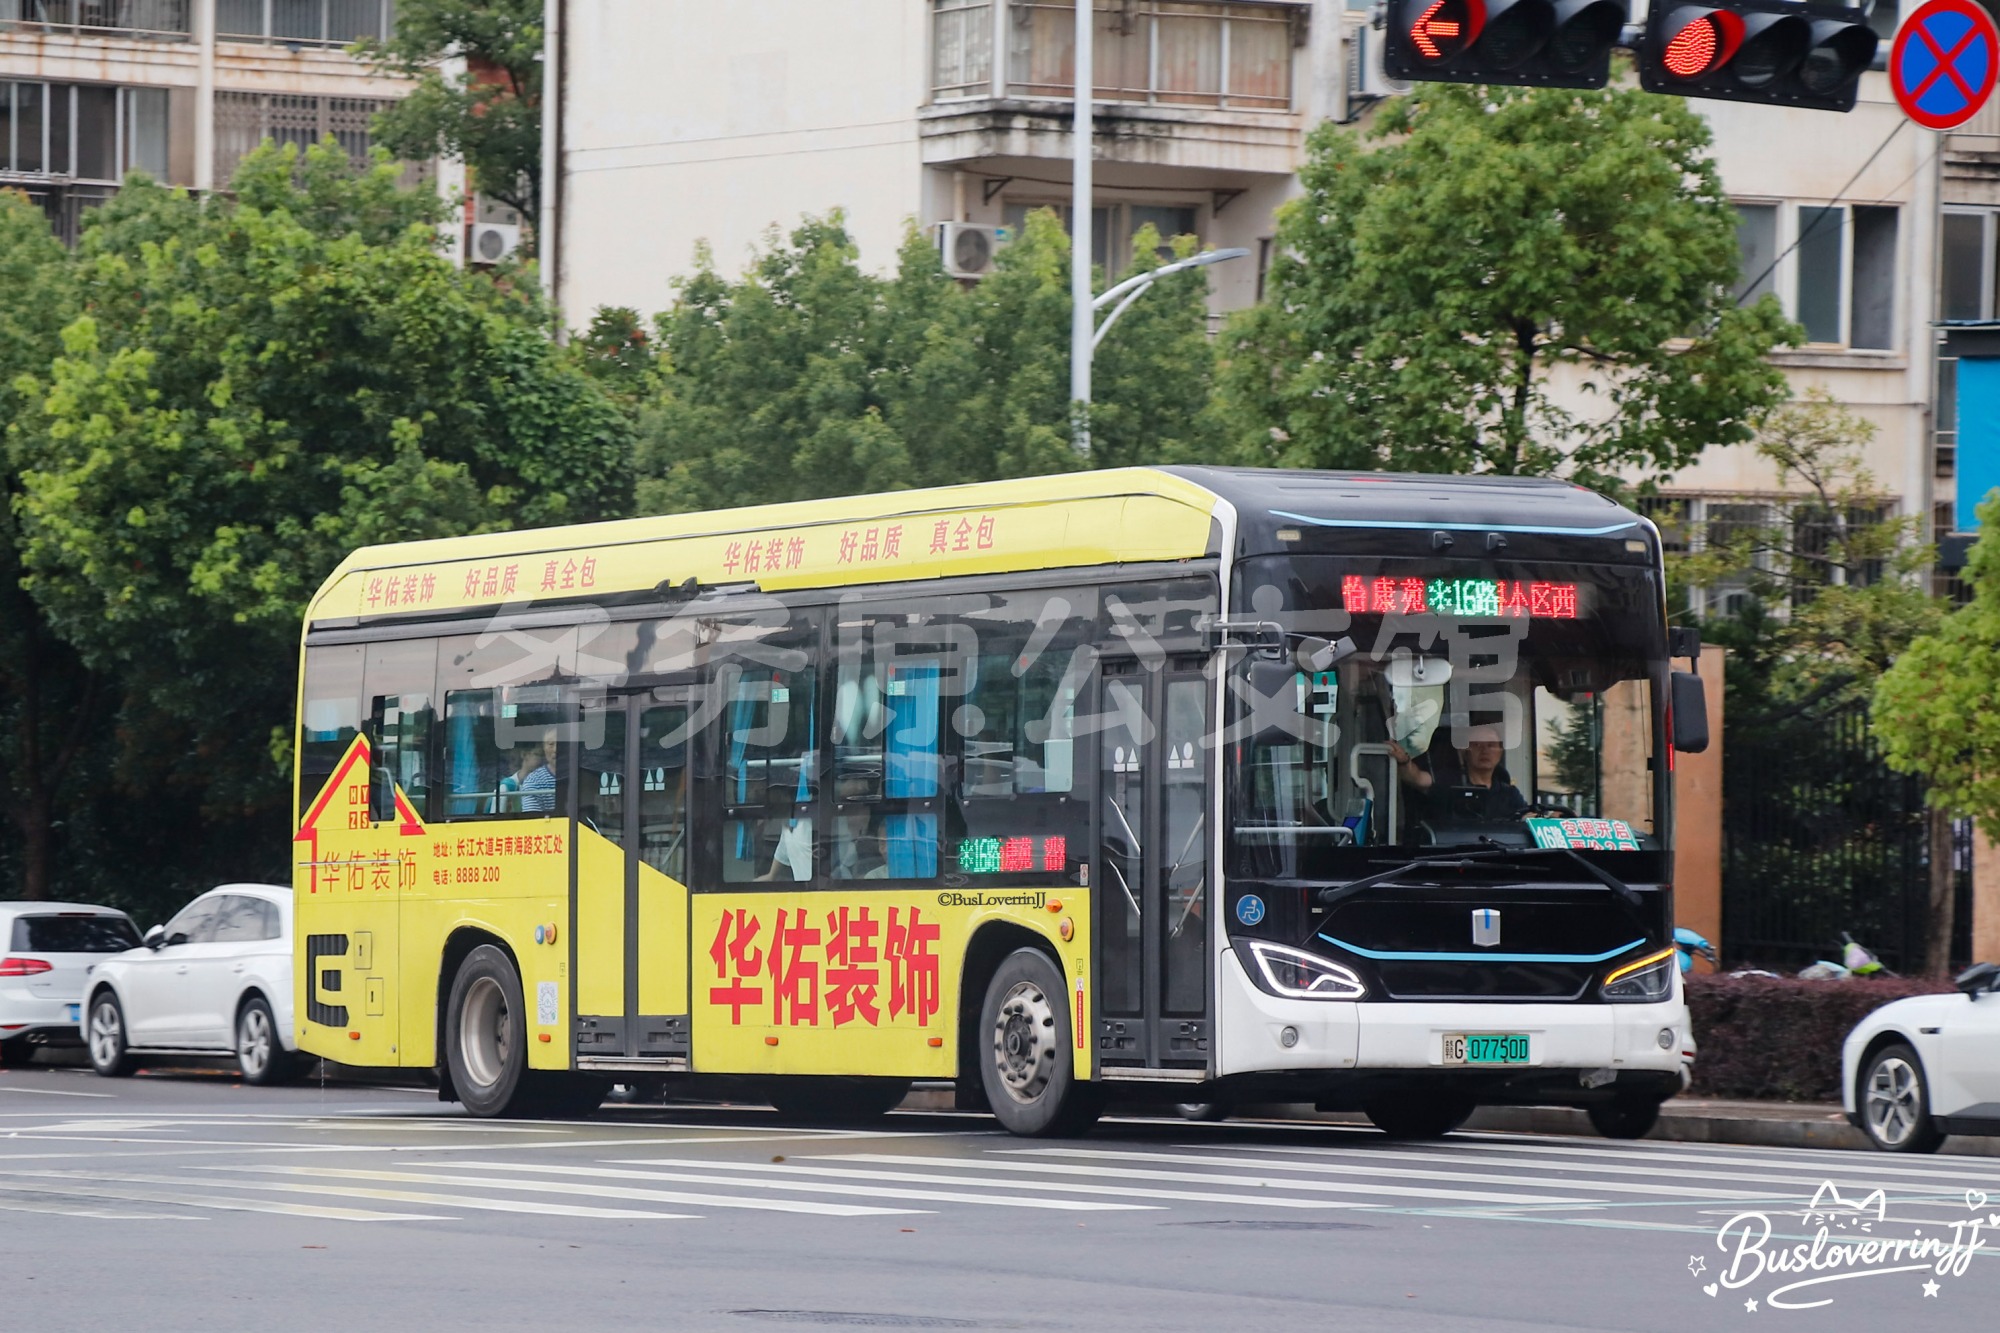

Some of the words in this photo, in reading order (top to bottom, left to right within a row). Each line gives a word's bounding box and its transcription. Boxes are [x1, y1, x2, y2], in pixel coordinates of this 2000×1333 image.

[722, 536, 806, 575] 华佑装饰
[837, 523, 904, 566] 好品质
[928, 514, 996, 555] 真全包
[366, 573, 437, 608] 华佑装饰
[462, 563, 520, 600] 好品质
[540, 556, 598, 593] 真全包
[1342, 575, 1427, 614] 怡康苑
[1560, 820, 1632, 840] 空调开启
[322, 847, 417, 893] 华佑装饰
[482, 866, 500, 882] 200
[709, 906, 941, 1029] 华佑装饰
